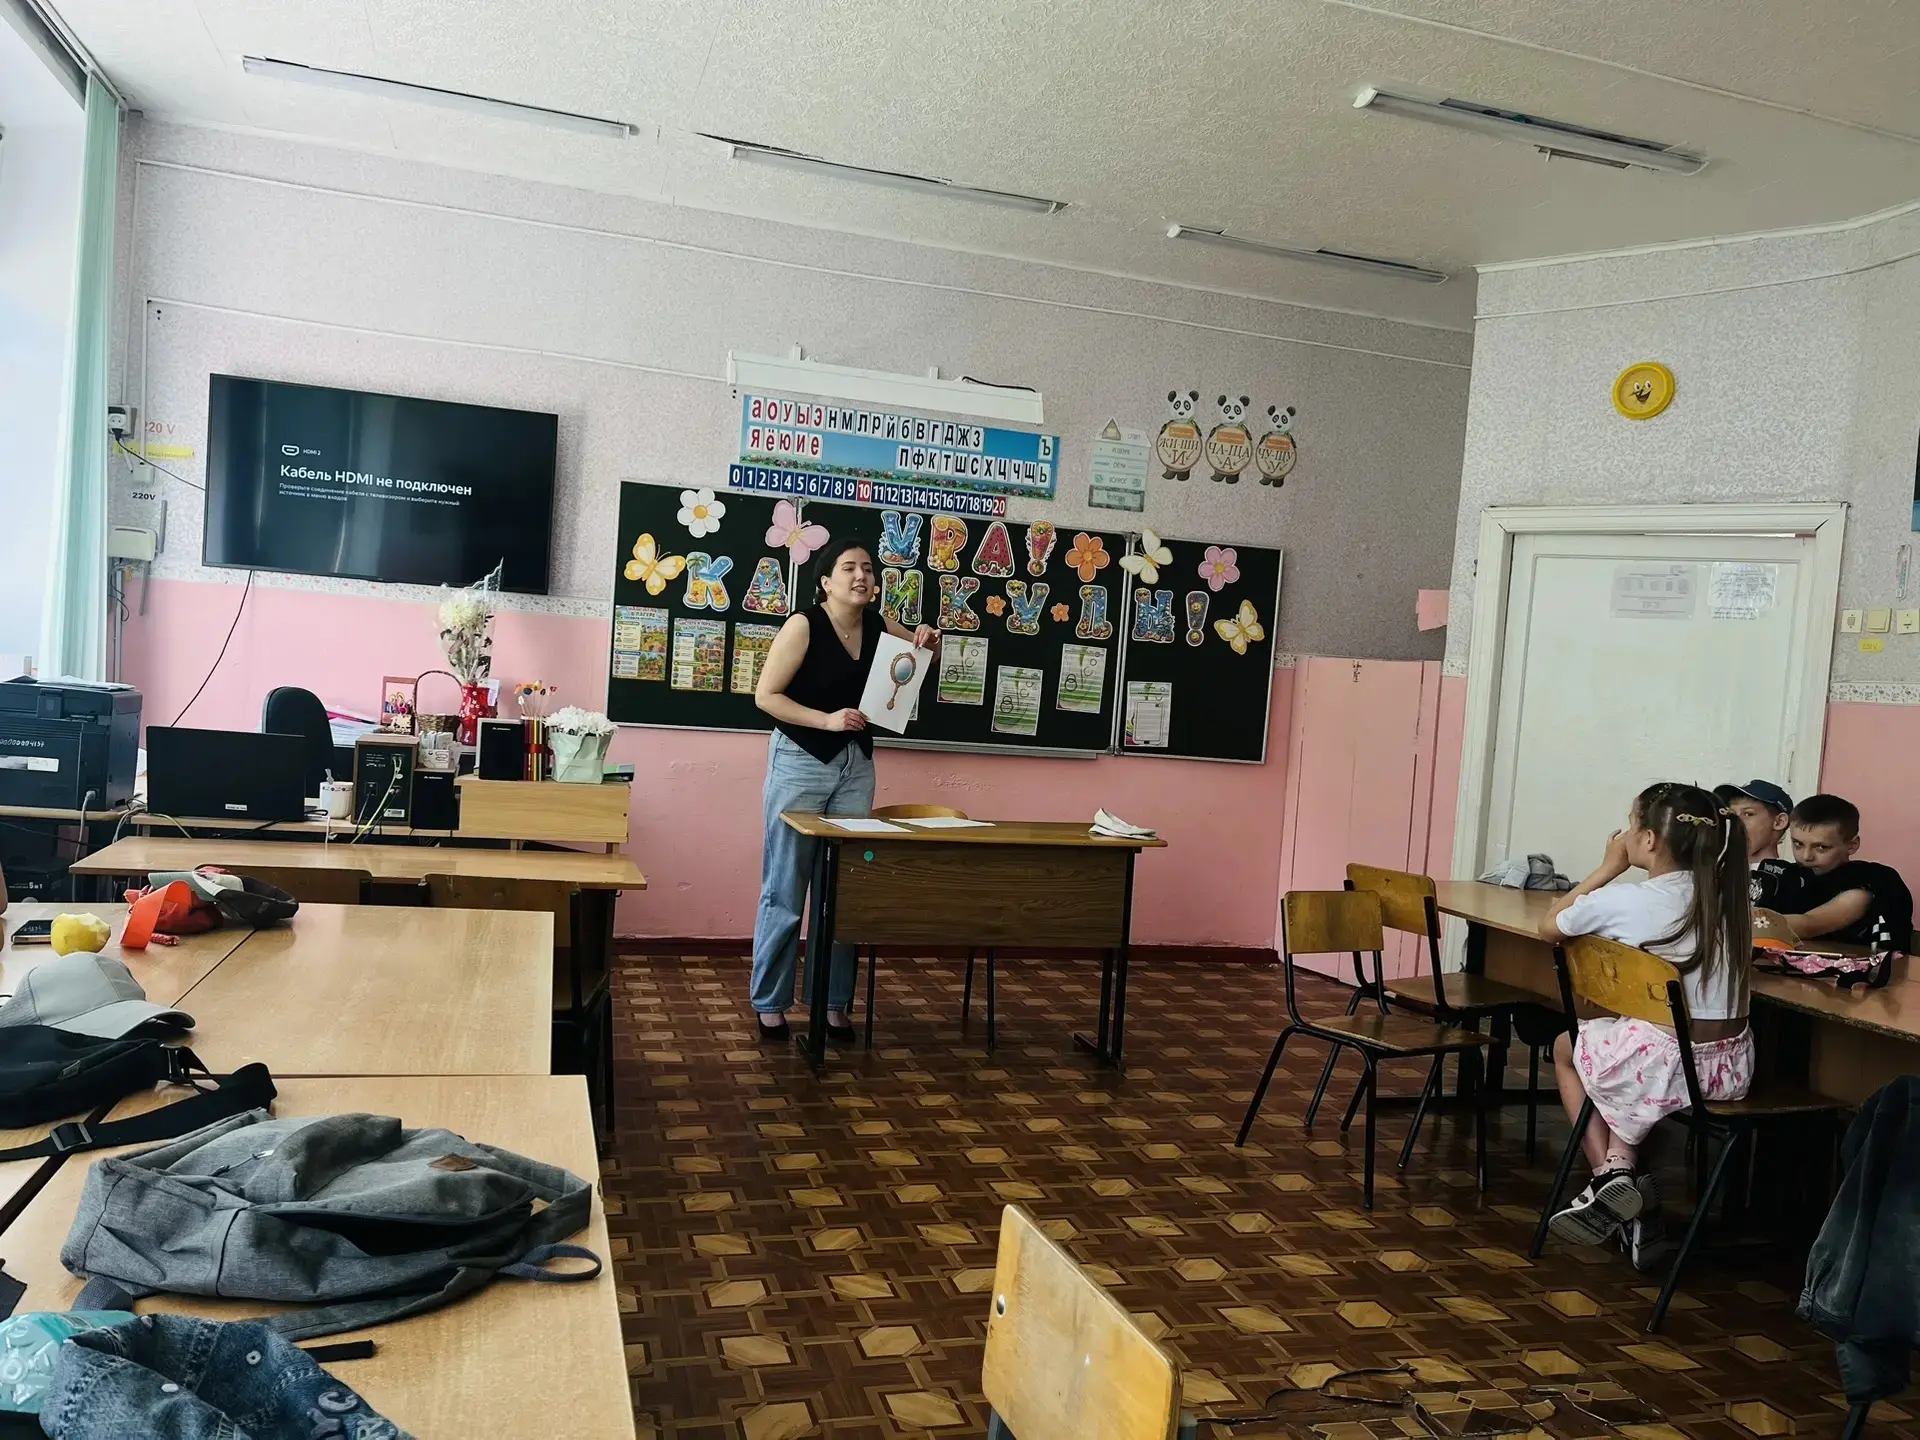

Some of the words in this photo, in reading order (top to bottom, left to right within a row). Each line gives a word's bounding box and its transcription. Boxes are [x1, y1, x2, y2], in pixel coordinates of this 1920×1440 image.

[167, 424, 176, 434] V
[1159, 438, 1199, 451] ЖИ-ШИ
[1208, 442, 1250, 458] ЧА-ЩА
[1171, 450, 1187, 465] И
[1259, 448, 1294, 461] ЧУ-ЩУ
[1221, 457, 1234, 470] А
[1270, 461, 1281, 474] У
[280, 464, 332, 481] Кабель
[335, 470, 373, 485] HDMI
[376, 477, 393, 488] не
[396, 479, 472, 496] подключен
[132, 492, 156, 501] 220V
[733, 468, 740, 483] 0
[747, 470, 753, 485] 1
[759, 471, 766, 487] 2
[771, 473, 778, 488] 3
[784, 475, 791, 489] 4
[797, 476, 804, 491] 5
[809, 478, 817, 492] 6
[822, 480, 829, 494] 7
[834, 481, 842, 495] 8
[847, 482, 854, 497] 9
[858, 484, 870, 499] 10
[873, 486, 884, 500] 11
[887, 487, 898, 502] 12
[900, 488, 911, 503] 13
[914, 490, 926, 505] 14
[928, 492, 939, 506] 15
[942, 493, 953, 508] 16
[955, 495, 966, 509] 17
[969, 496, 980, 511] 18
[982, 497, 993, 513] 19
[993, 499, 1005, 514] 20
